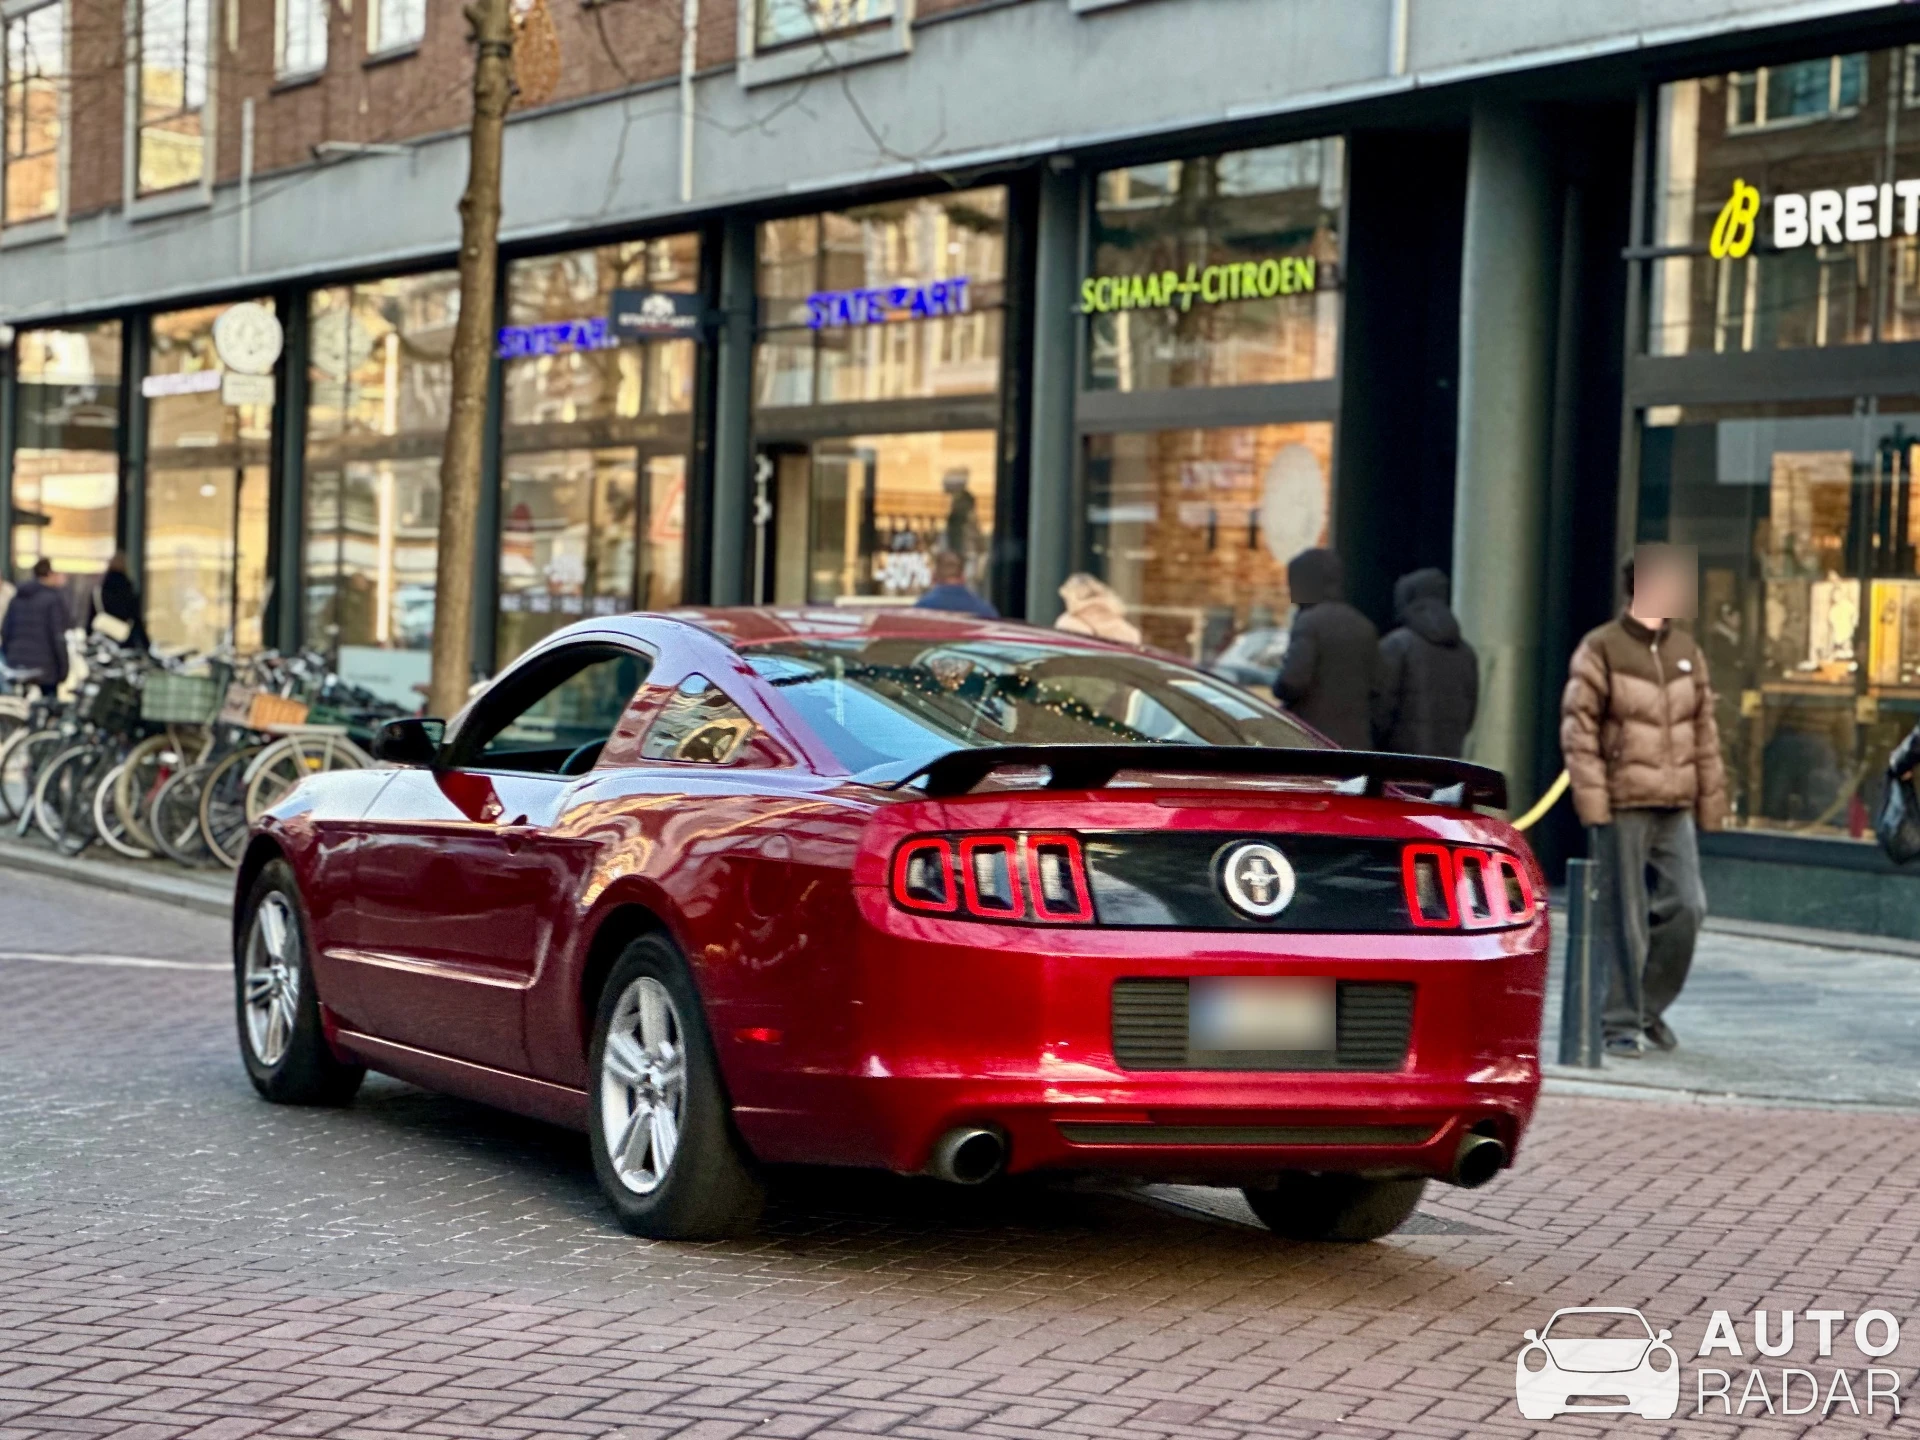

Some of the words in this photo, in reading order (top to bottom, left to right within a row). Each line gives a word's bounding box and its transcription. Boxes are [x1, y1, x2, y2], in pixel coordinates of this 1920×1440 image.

[1773, 178, 1920, 249] BREIT
[806, 287, 886, 329] STATE
[911, 274, 971, 319] ART
[573, 316, 619, 350] AR
